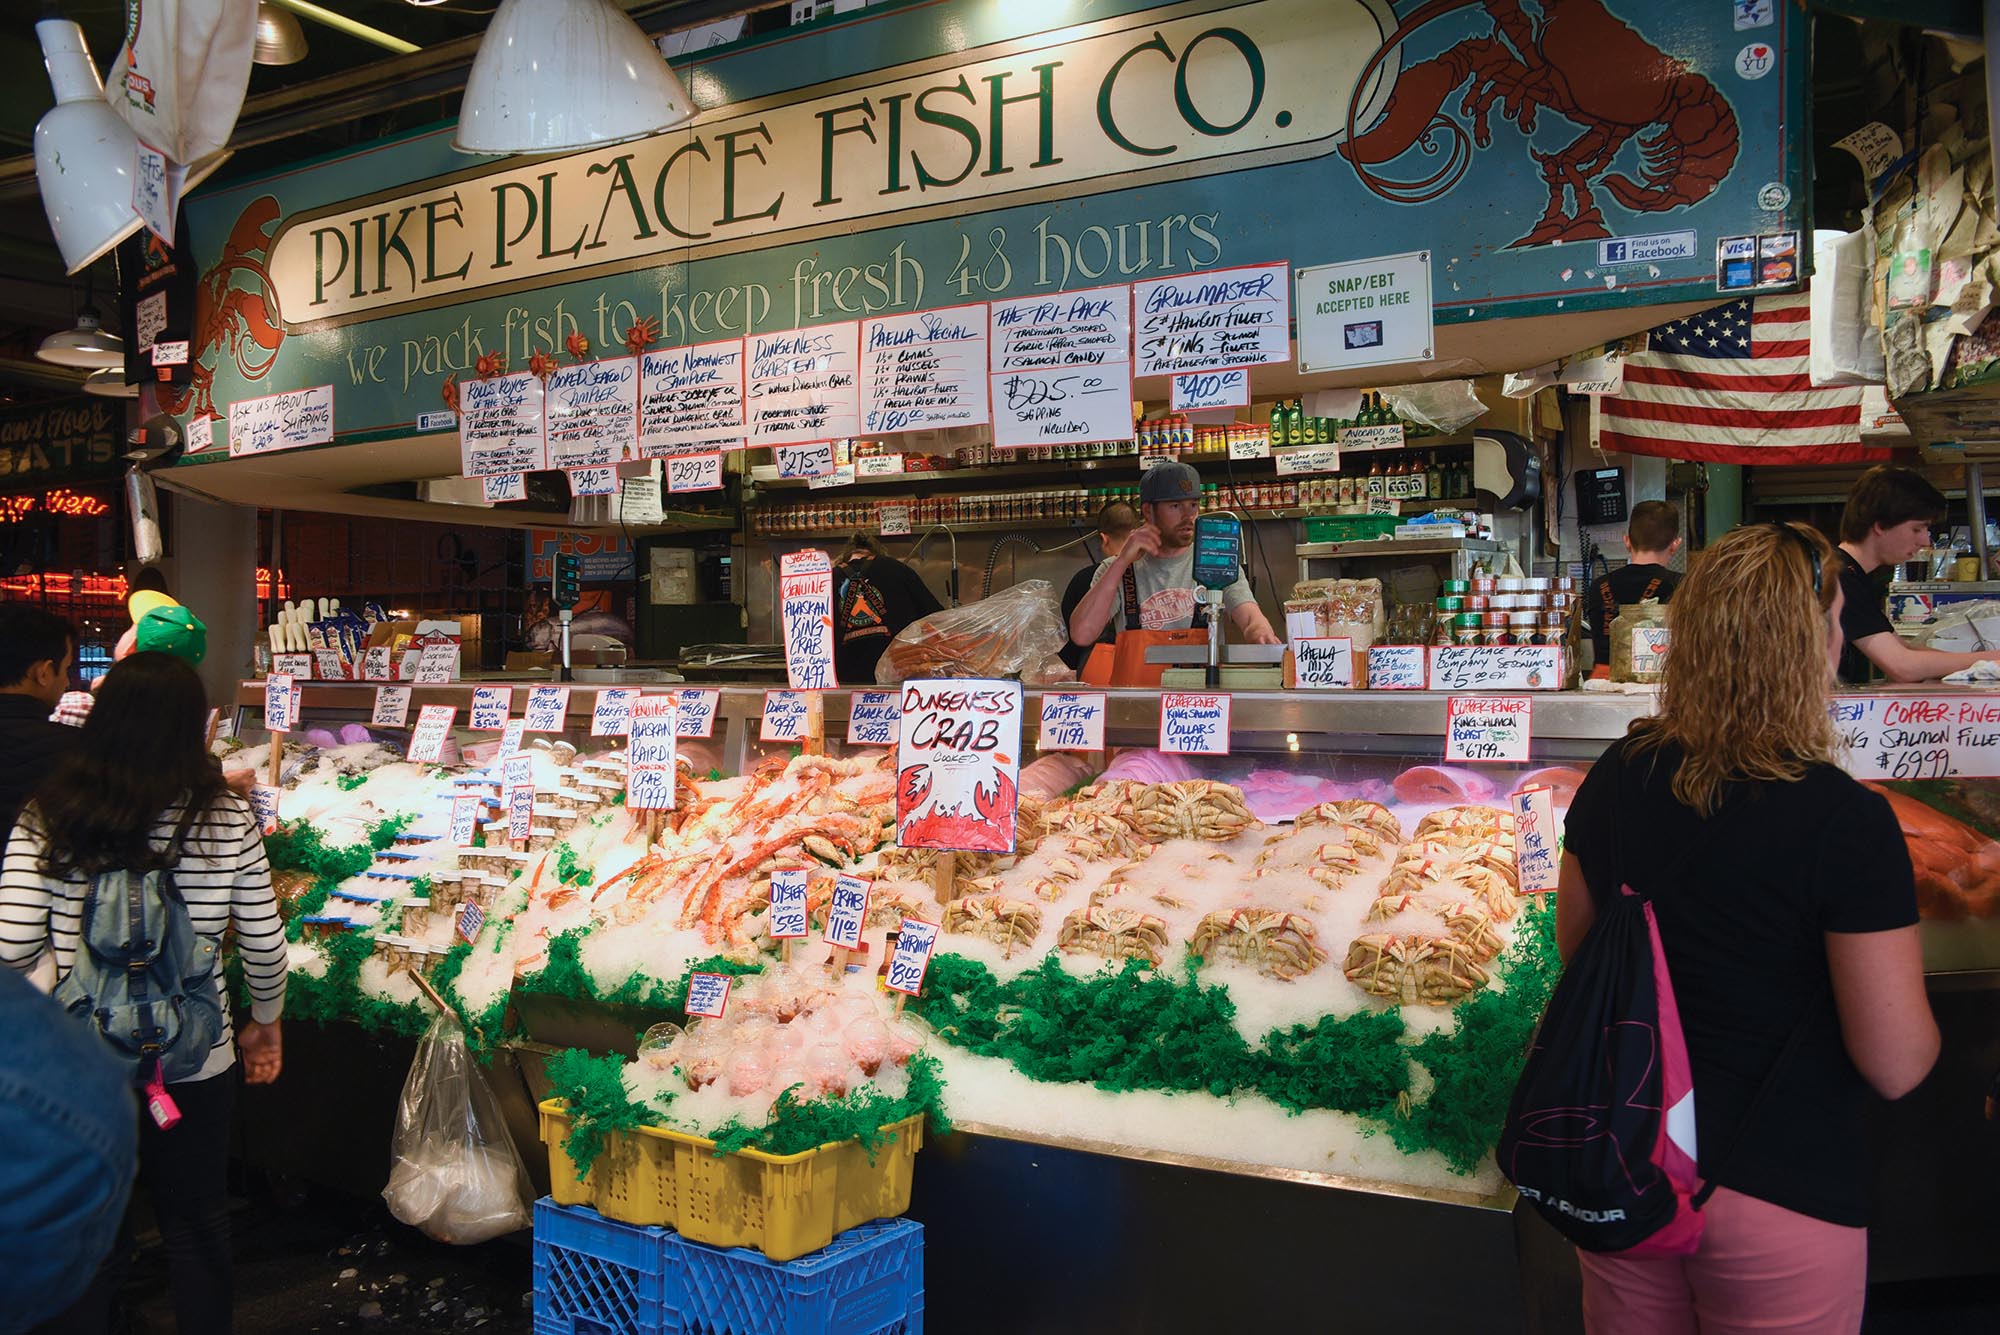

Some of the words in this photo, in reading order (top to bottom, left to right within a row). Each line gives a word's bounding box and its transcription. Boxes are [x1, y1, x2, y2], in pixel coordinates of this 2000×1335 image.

[309, 191, 474, 307] PIKE
[491, 121, 784, 269] PLACE
[814, 60, 1063, 208] FISH
[1096, 27, 1292, 156] CO.
[1631, 240, 1649, 248] Find
[1631, 244, 1687, 260] Facebook
[1727, 243, 1753, 255] VISA
[1145, 273, 1278, 314] GRILLMASTER
[1328, 274, 1395, 295] SNAP/EBT
[348, 346, 390, 386] we
[403, 314, 485, 393] pack
[501, 297, 579, 361] fish
[594, 294, 639, 349] to
[658, 280, 771, 346] keep
[789, 240, 927, 329] fresh
[946, 226, 1013, 296] 48
[1020, 210, 1220, 292] hours
[1316, 296, 1374, 315] ACCEPTED
[1379, 291, 1411, 306] HERE
[993, 306, 1029, 327] THE
[1170, 311, 1224, 331] HALIBUT
[1225, 303, 1273, 328] FILLETS
[869, 323, 921, 352] PAELLA
[919, 313, 978, 341] SPECIAL
[1013, 327, 1065, 339] TRADITIONAL
[1070, 323, 1107, 333] SMOKED
[1078, 334, 1116, 345] SMOKED
[754, 333, 833, 364] DUNGENESS
[1167, 336, 1204, 357] KING
[1213, 328, 1260, 342] SALMON
[642, 356, 679, 380] PACIFIC
[683, 347, 742, 375] NORTHWEST
[897, 347, 934, 362] CLAMS
[1011, 352, 1062, 367] SALMON
[1064, 351, 1106, 364] CANDY
[1221, 352, 1267, 364] SEASONING
[896, 358, 940, 373] MUSSELS
[547, 369, 587, 392] COOKED
[586, 363, 633, 387] SEAFOOD
[656, 370, 723, 393] SAMPLER
[829, 374, 853, 388] CRAB
[895, 372, 936, 384] PRAWNS
[1177, 371, 1242, 400] $400.00
[1576, 376, 1617, 392] EARTH!
[467, 382, 496, 402] ROLLS
[499, 377, 534, 397] ROYCE
[648, 393, 679, 405] WHOLE
[679, 387, 719, 401] SOCKEYE
[1003, 375, 1103, 411] $225.00
[233, 403, 253, 422] ASK
[257, 400, 270, 413] US
[272, 389, 318, 415] ABOUT
[484, 398, 501, 409] THE
[501, 395, 528, 407] SEA
[611, 403, 633, 416] CRAB
[643, 404, 676, 417] SILVER
[884, 398, 913, 410] PAELLA
[915, 395, 937, 407] RICE
[937, 395, 958, 406] MIX
[483, 409, 500, 420] KING
[501, 406, 518, 418] CRAB
[673, 412, 710, 424] DUNGENESS
[713, 408, 734, 420] CRAB
[761, 408, 799, 420] COCKTAIL
[801, 404, 834, 416] SAUCE
[1017, 407, 1062, 421] SHIPPING
[232, 423, 250, 440] OUR
[252, 420, 280, 436] LOCAL
[281, 409, 329, 433] SHIPPING
[800, 417, 831, 429] SAUCE
[1039, 420, 1090, 437] INCLUDED
[562, 431, 580, 441] KING
[1345, 428, 1385, 439] AVOCADO
[779, 447, 833, 472] $275.00
[572, 468, 610, 489] $340.00
[672, 460, 717, 482] $289.00
[782, 577, 831, 600] GENUINE
[784, 597, 829, 617] ALASKAN
[1141, 610, 1157, 623] OFF
[791, 616, 826, 639] KING
[790, 637, 822, 656] CRAB
[1297, 641, 1346, 662] PAELLA
[1385, 649, 1416, 657] PLACE
[1438, 647, 1469, 661] PIKE
[1470, 647, 1506, 659] PLACE
[1514, 646, 1542, 657] FISH
[1308, 660, 1334, 672] MIX
[1391, 663, 1417, 671] GLASS
[1436, 658, 1489, 673] COMPANY
[791, 665, 824, 688] $34.99
[1441, 671, 1488, 688] $5.00
[528, 697, 551, 710] TRUE
[551, 698, 564, 710] COD
[630, 698, 670, 719] GENUINE
[765, 700, 789, 714] DOVER
[903, 685, 1015, 715] DUNGENESS
[692, 702, 711, 717] COD
[853, 704, 883, 721] BLACK
[1167, 708, 1188, 720] KING
[1188, 708, 1222, 720] SALMON
[631, 717, 671, 738] ALASKAN
[1167, 719, 1215, 736] COLLARS
[1454, 716, 1477, 728] KING
[1477, 714, 1517, 728] SALMON
[855, 725, 889, 743] $28.99
[911, 712, 1000, 755] CRAB
[1048, 728, 1084, 745] $11.99
[1453, 728, 1487, 741] ROAST
[1880, 725, 1950, 748] SALMON
[1168, 735, 1204, 751] $19.99
[1456, 743, 1498, 758] $67.99
[932, 752, 980, 763] COOKED
[1876, 749, 1949, 779] $69.99
[633, 771, 662, 789] CRAB
[1516, 811, 1538, 833] SHIP
[1524, 831, 1543, 850] FISH
[770, 879, 807, 904] OYSTER
[831, 886, 864, 911] CRAB
[772, 913, 804, 932] $5.00
[830, 914, 857, 942] $11.00
[895, 930, 935, 955] SHRIMP
[891, 961, 921, 985] $8.00
